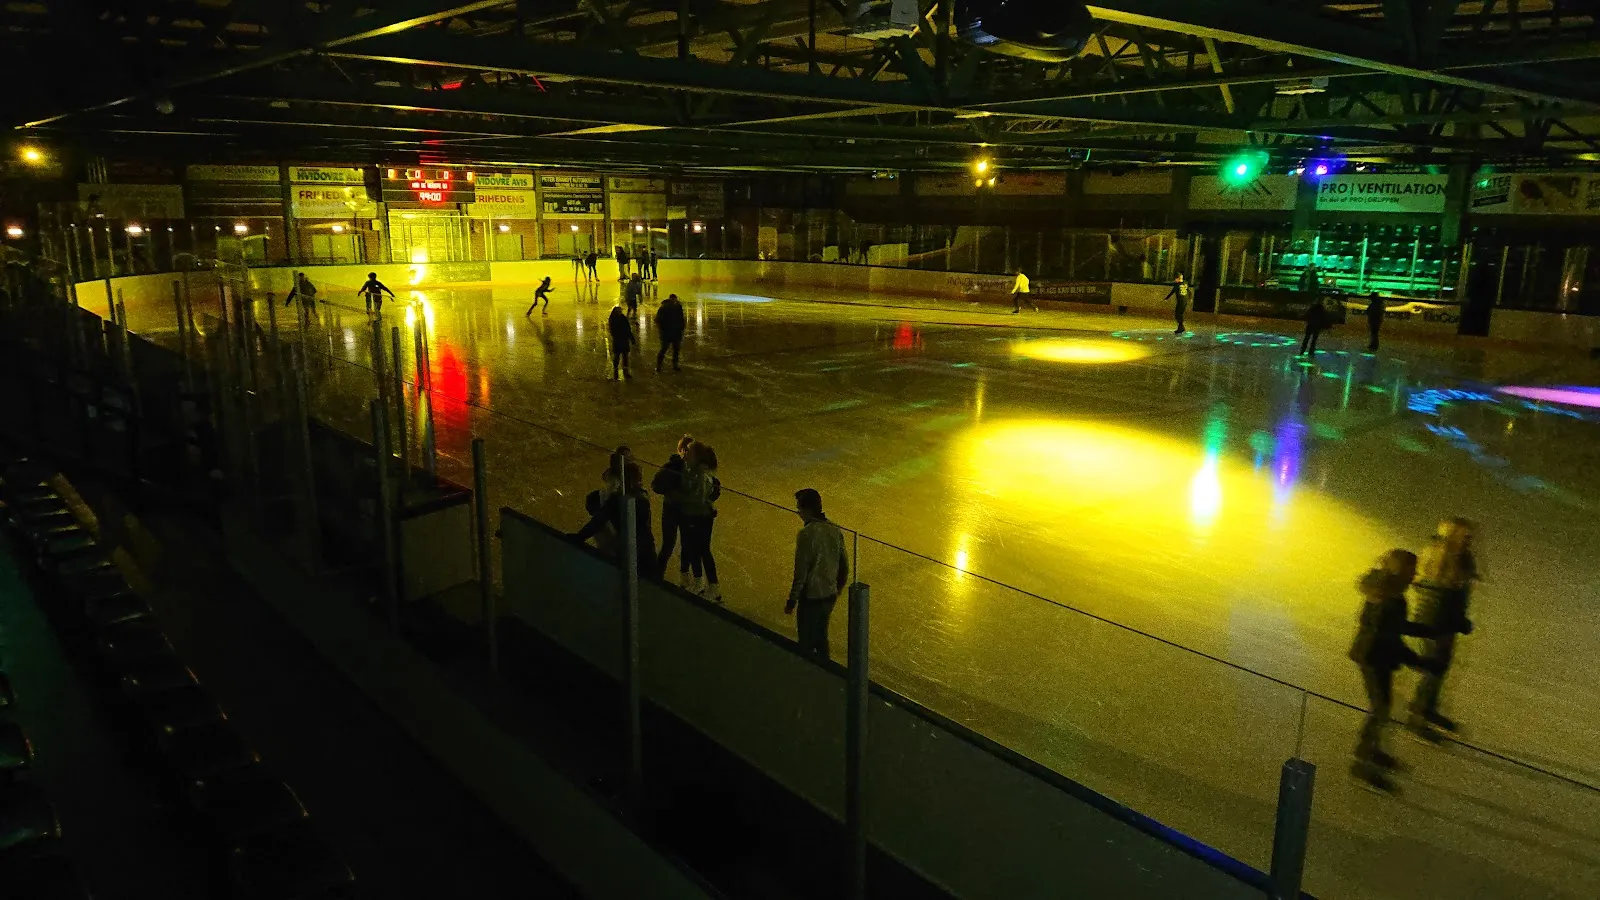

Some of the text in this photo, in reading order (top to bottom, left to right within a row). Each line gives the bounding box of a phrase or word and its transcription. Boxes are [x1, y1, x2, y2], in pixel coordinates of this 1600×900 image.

[475, 177, 528, 186] VIDOVRE AVIS
[1321, 183, 1447, 195] PRO VENTILATION
